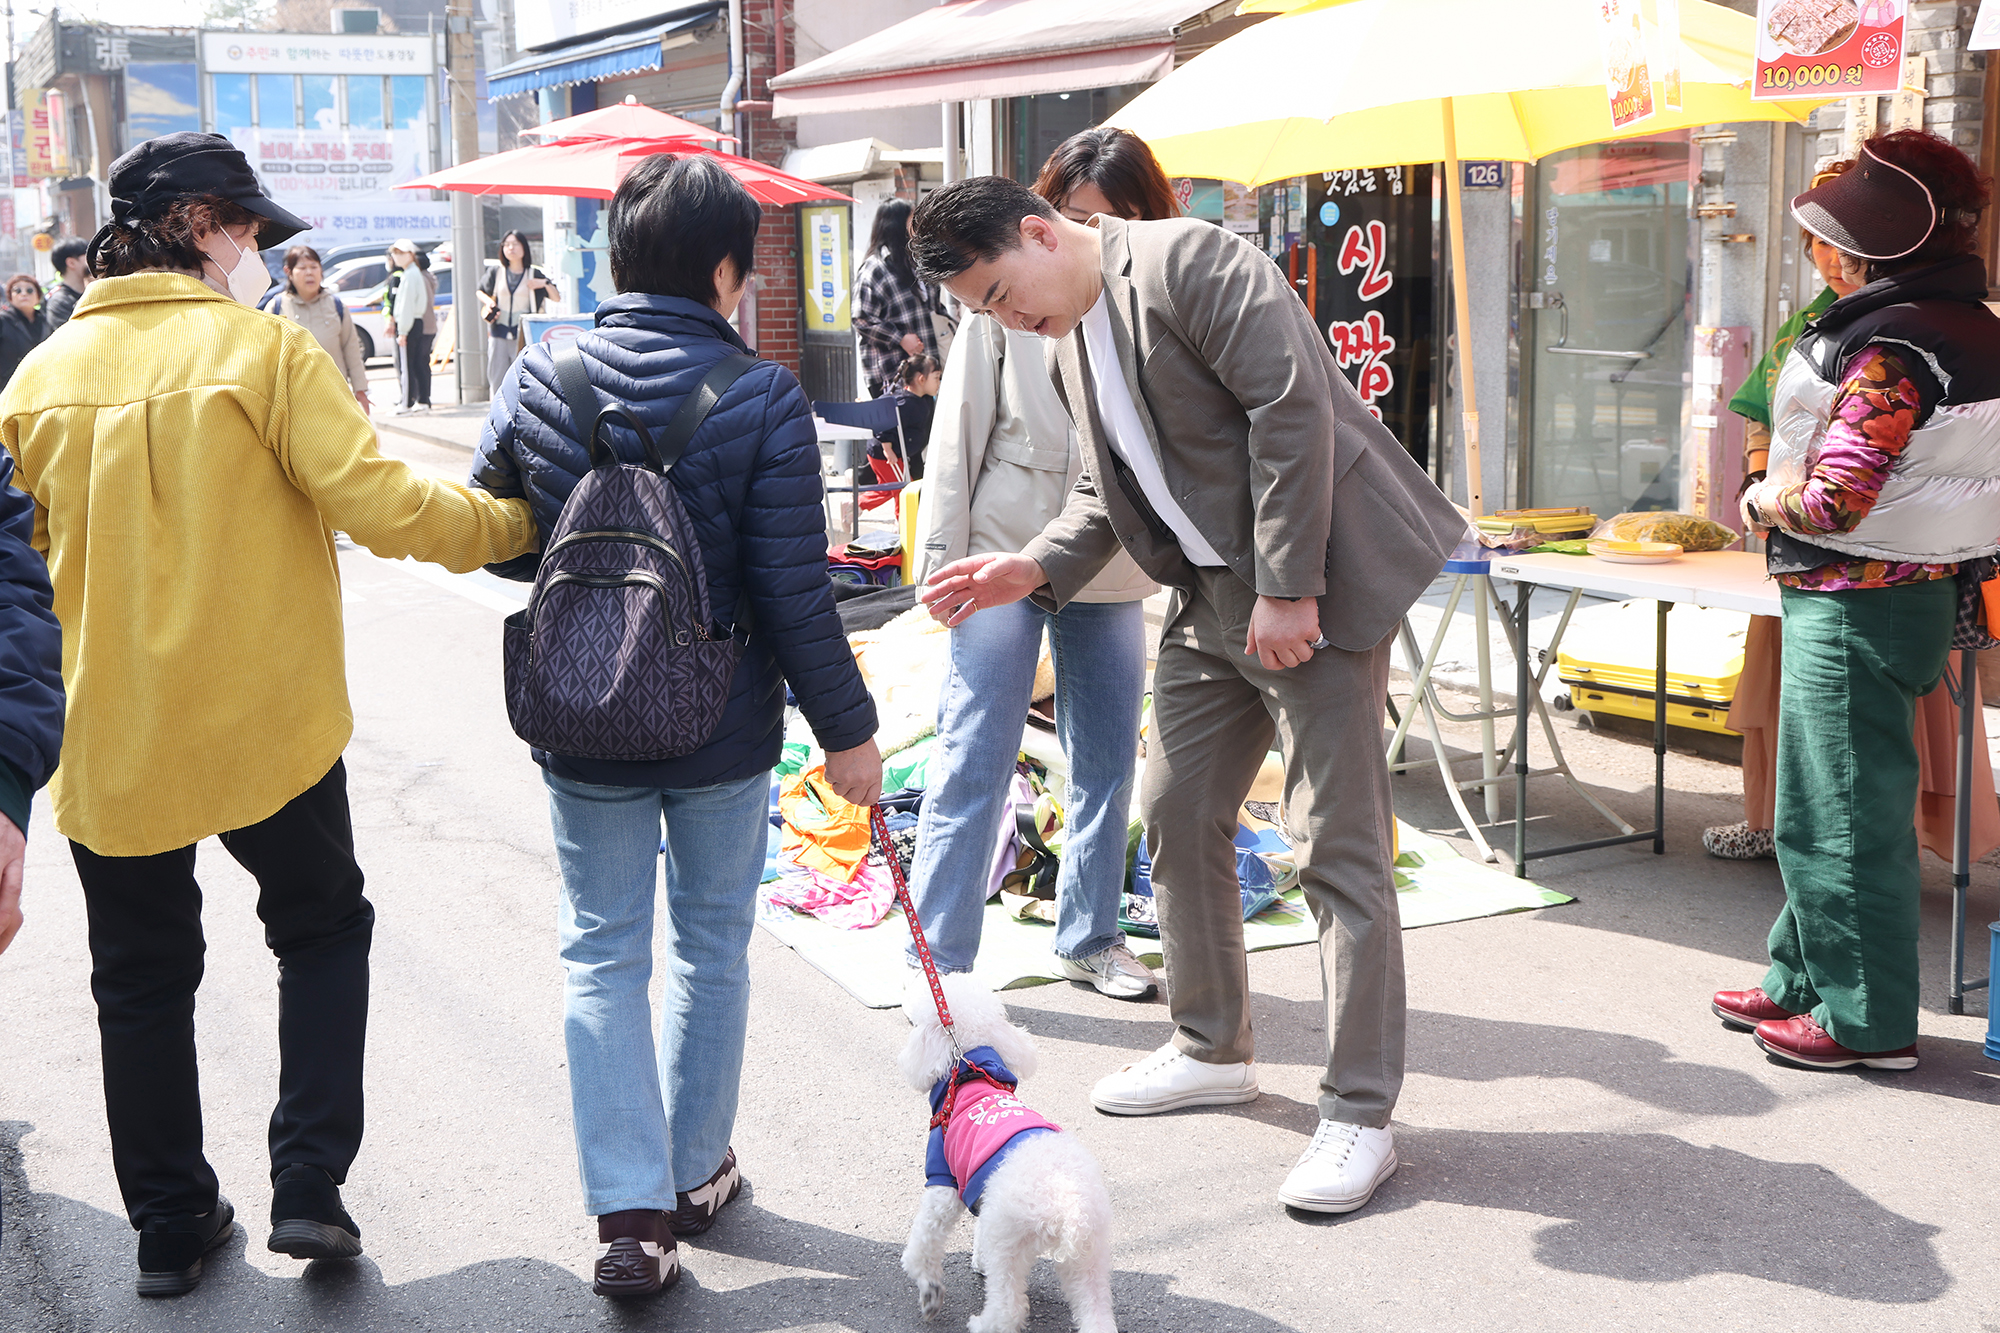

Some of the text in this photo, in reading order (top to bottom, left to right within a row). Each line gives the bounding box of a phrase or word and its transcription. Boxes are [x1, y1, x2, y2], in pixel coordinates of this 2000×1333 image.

[95, 37, 132, 71] 張
[245, 46, 280, 61] 주민과
[286, 46, 331, 61] 함께하는
[1762, 63, 1864, 91] 10,000 원
[259, 141, 346, 161] 보이스피싱
[1322, 164, 1404, 197] 맛있는 집
[1468, 165, 1499, 185] 126
[332, 215, 368, 230] 주민과
[1329, 219, 1396, 422] 신짬
